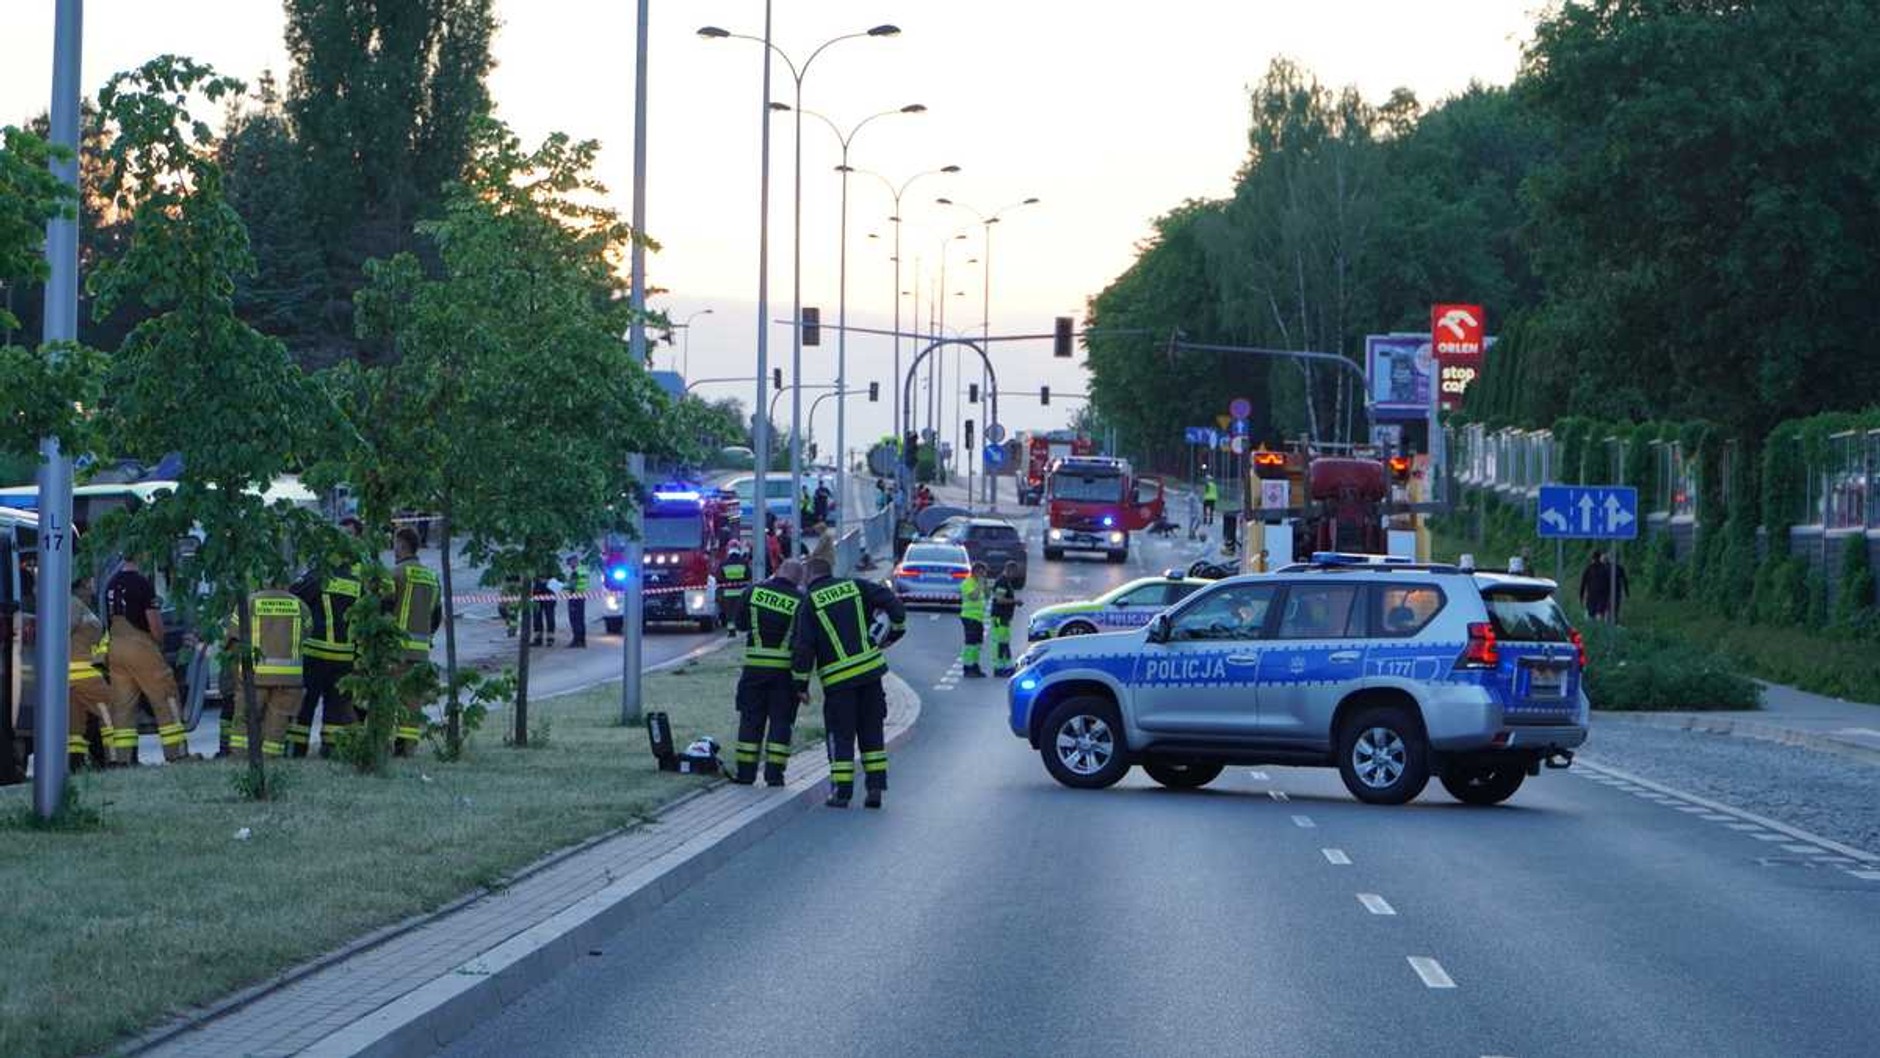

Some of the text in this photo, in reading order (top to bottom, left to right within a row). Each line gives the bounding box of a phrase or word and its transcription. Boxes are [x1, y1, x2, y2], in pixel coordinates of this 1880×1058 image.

[1437, 342, 1479, 354] ORLEN
[1442, 366, 1475, 383] stop
[1442, 380, 1467, 394] caf
[50, 513, 61, 529] L
[44, 534, 64, 551] 17
[1146, 657, 1226, 680] POLICJA
[1389, 661, 1411, 677] 177
